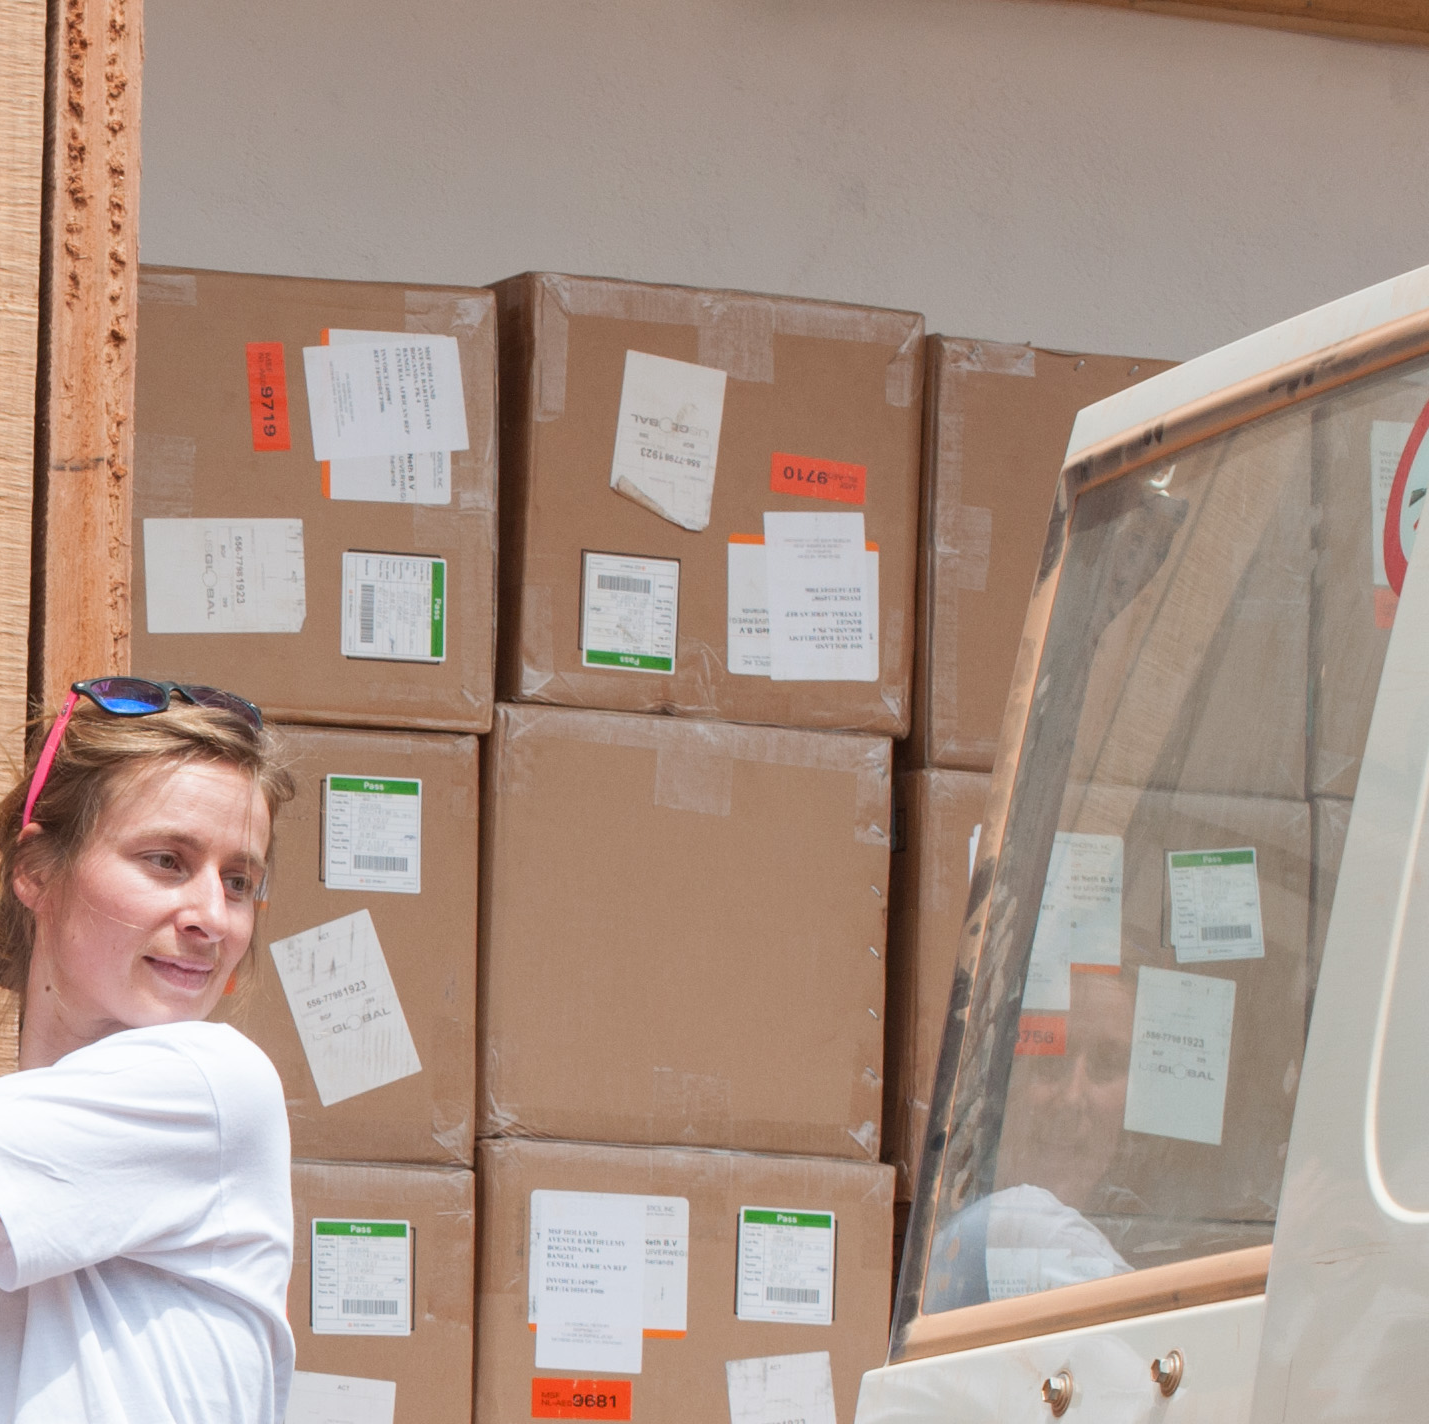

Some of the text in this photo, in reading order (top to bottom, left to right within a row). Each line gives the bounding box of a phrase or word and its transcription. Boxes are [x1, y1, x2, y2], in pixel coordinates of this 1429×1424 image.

[260, 386, 277, 437] 9719
[783, 466, 828, 485] 9710
[434, 598, 442, 621] Pass
[619, 656, 640, 666] Pass
[363, 781, 385, 791] Pass
[1015, 1029, 1055, 1046] 756
[776, 1214, 798, 1224] Pass
[350, 1224, 372, 1234] Pass
[572, 1393, 618, 1409] 9681
